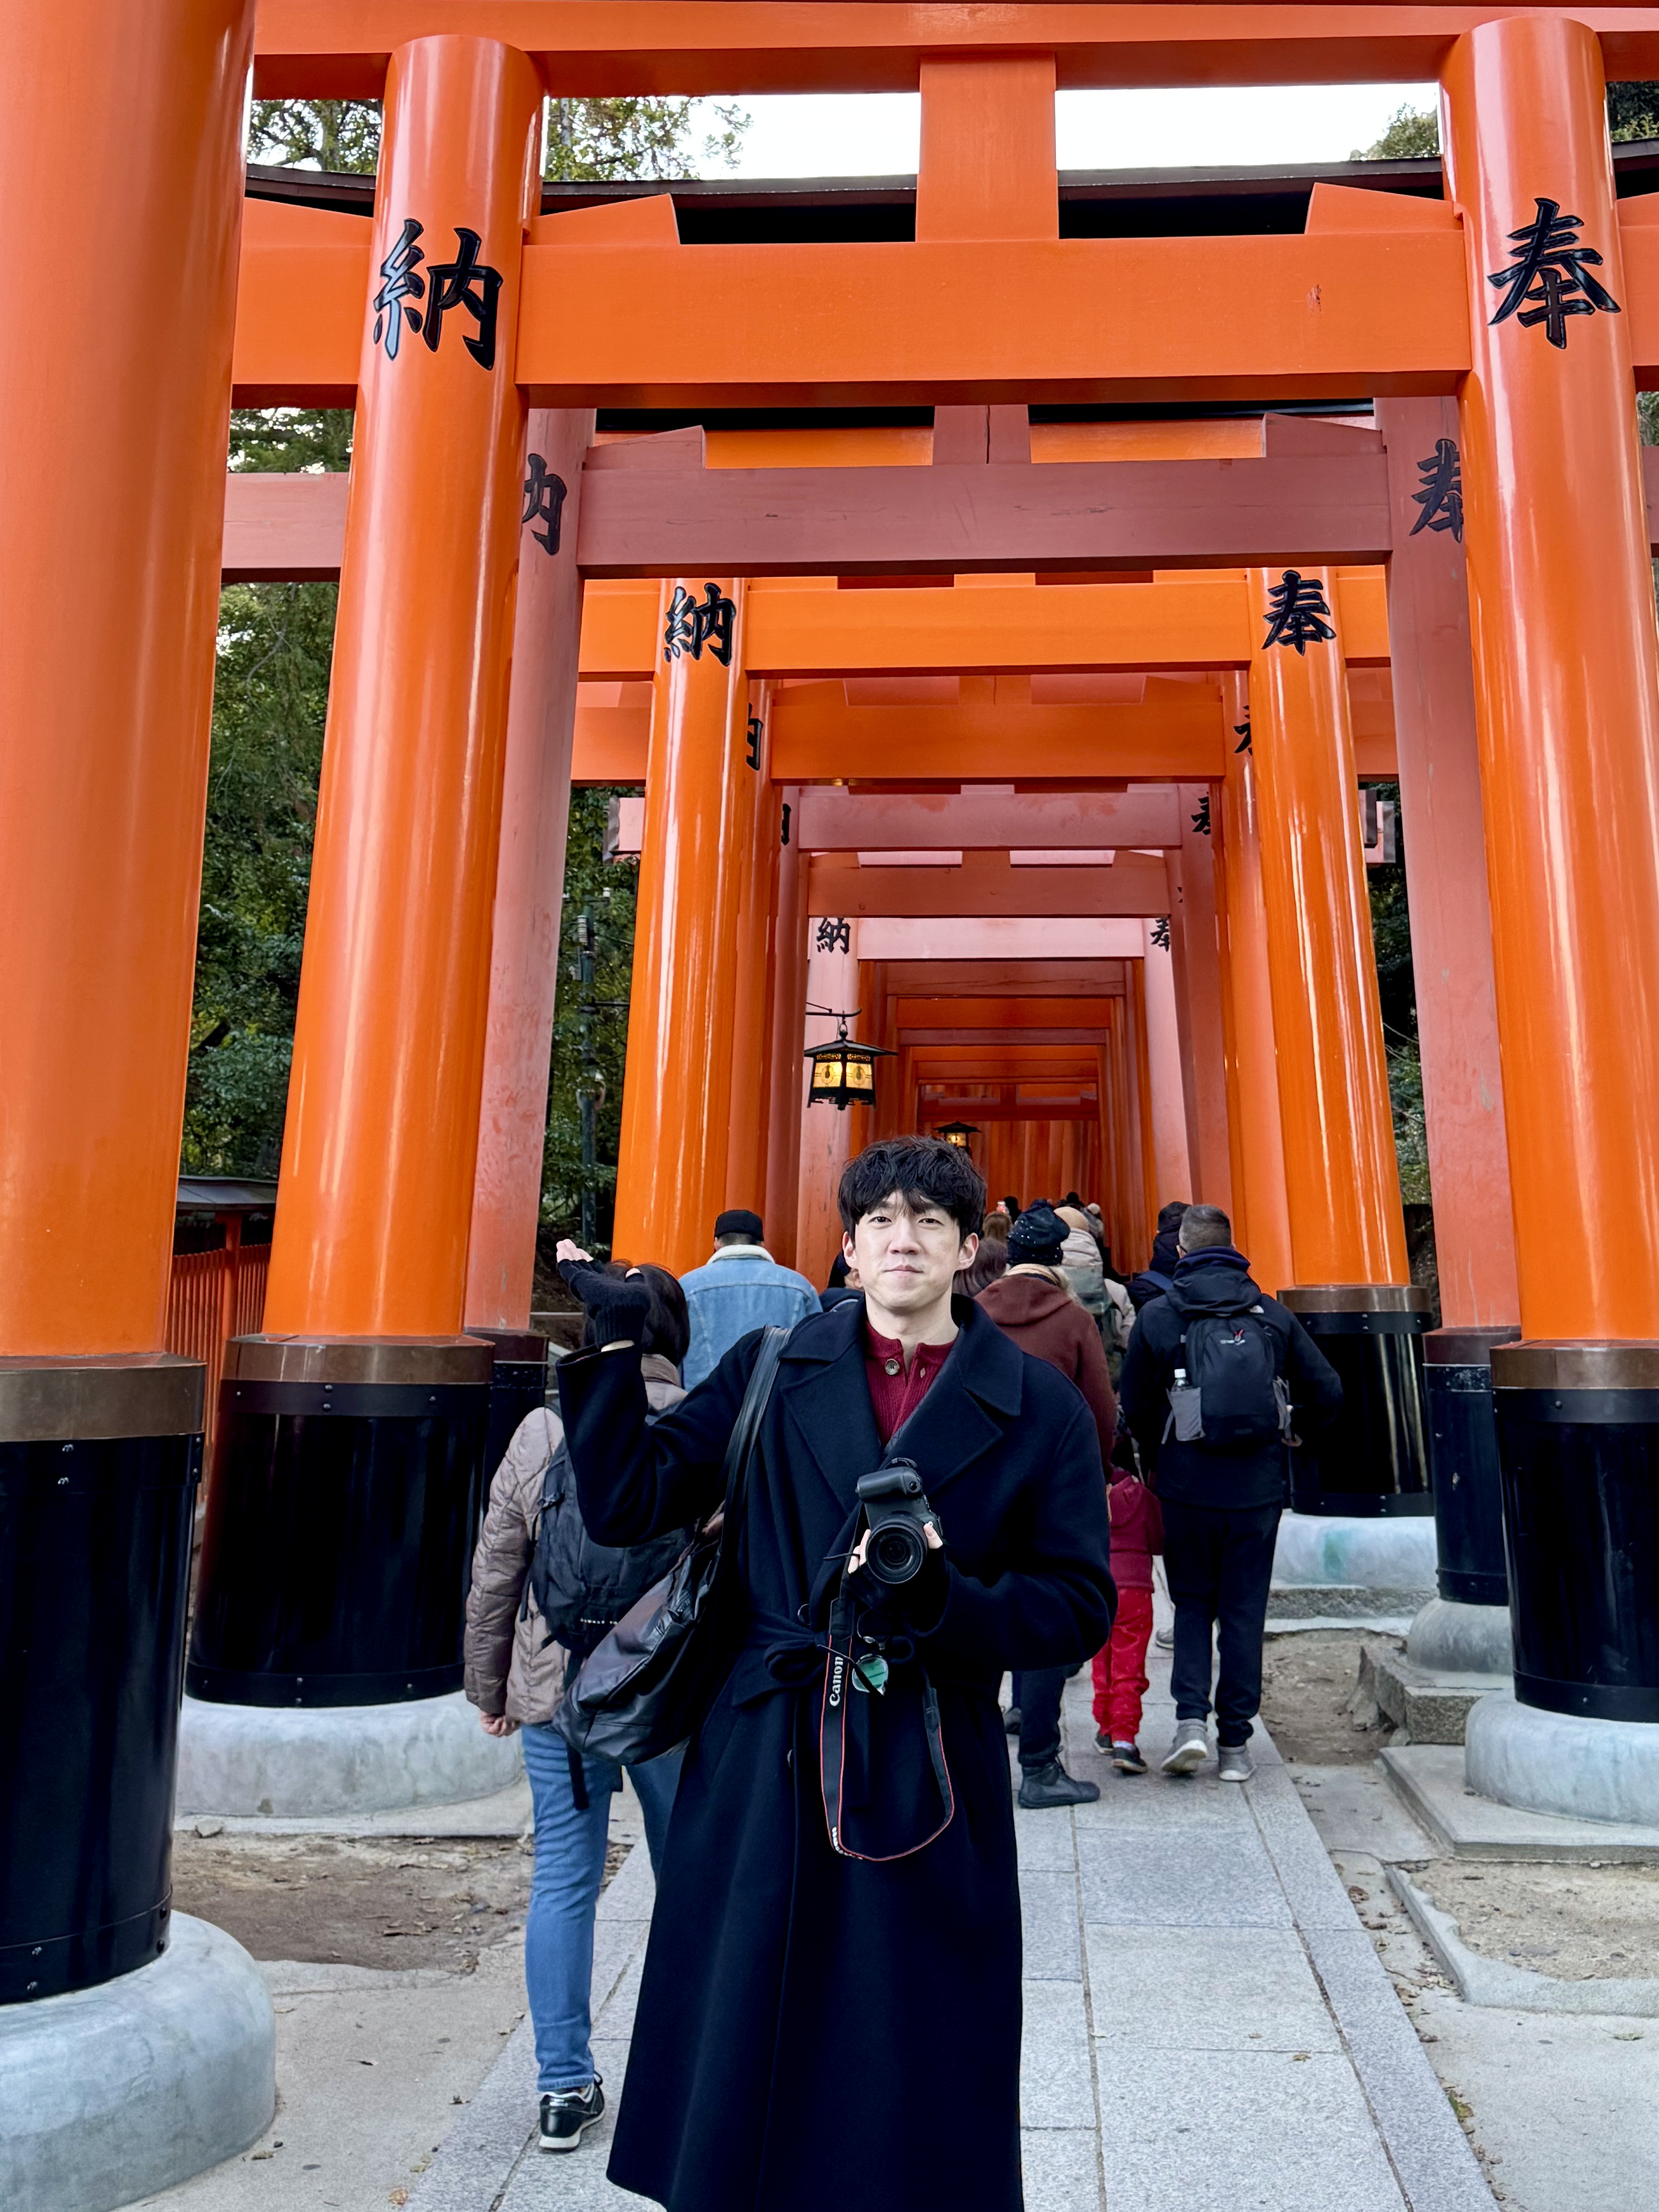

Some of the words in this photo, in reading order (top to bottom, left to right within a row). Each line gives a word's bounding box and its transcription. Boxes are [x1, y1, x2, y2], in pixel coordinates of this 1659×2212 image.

[373, 218, 504, 371] 納
[1487, 197, 1622, 349] 奉
[664, 582, 737, 667] 納
[1261, 570, 1337, 656] 奉
[816, 917, 851, 954] 納
[829, 1656, 843, 1706] Canon
